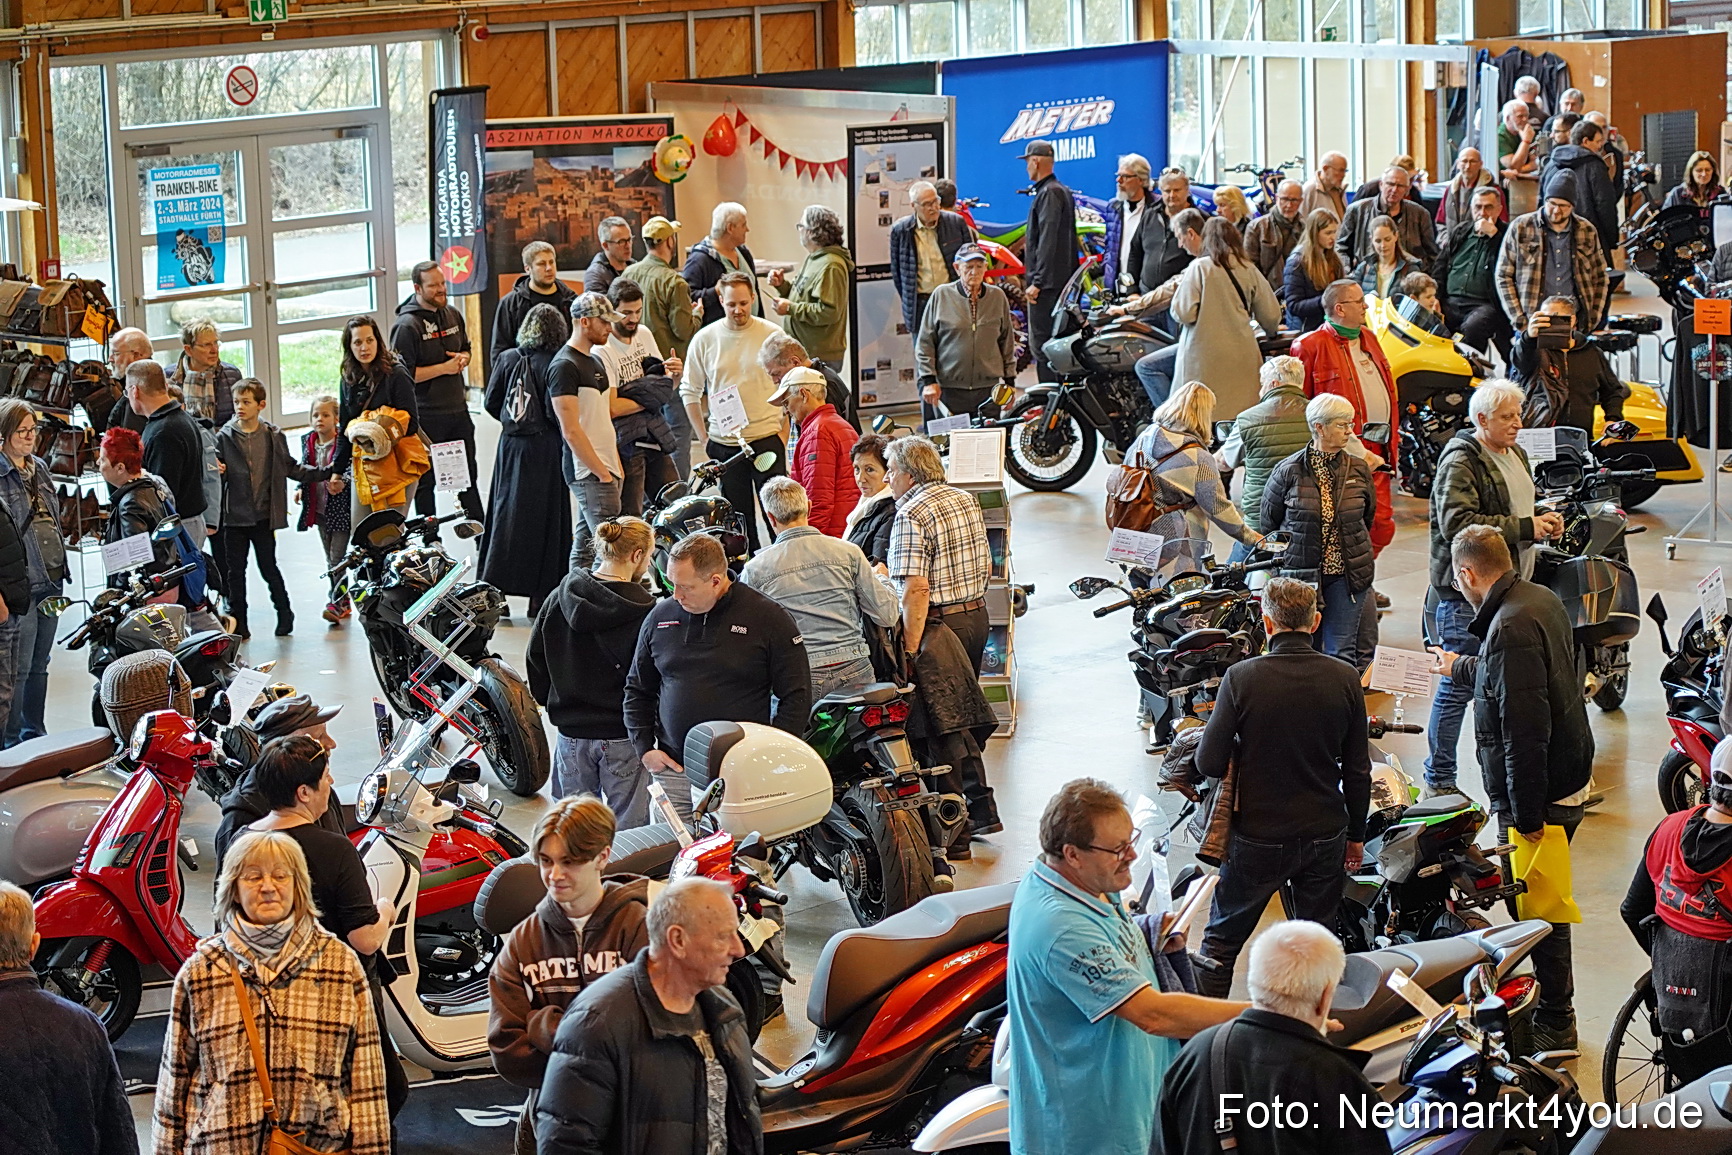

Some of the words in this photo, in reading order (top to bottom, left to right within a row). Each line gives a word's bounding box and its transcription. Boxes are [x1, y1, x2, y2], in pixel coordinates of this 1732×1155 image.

[592, 125, 666, 139] MAROKKO
[999, 100, 1116, 144] MEYER
[1048, 136, 1097, 162] AMAHA
[154, 167, 217, 180] MOTORRADMESSE
[446, 108, 462, 238] MOTORRADTOUREN
[155, 179, 219, 198] FRANKEN-BIKE
[157, 202, 177, 215] 2.-3.
[177, 199, 198, 213] März
[200, 197, 221, 211] 2024
[438, 168, 450, 238] LAMGARDA
[459, 170, 475, 237] MAROKKO
[159, 212, 199, 225] STADTHALLE
[200, 210, 222, 221] FÜRTH
[1081, 958, 1117, 985] 1967
